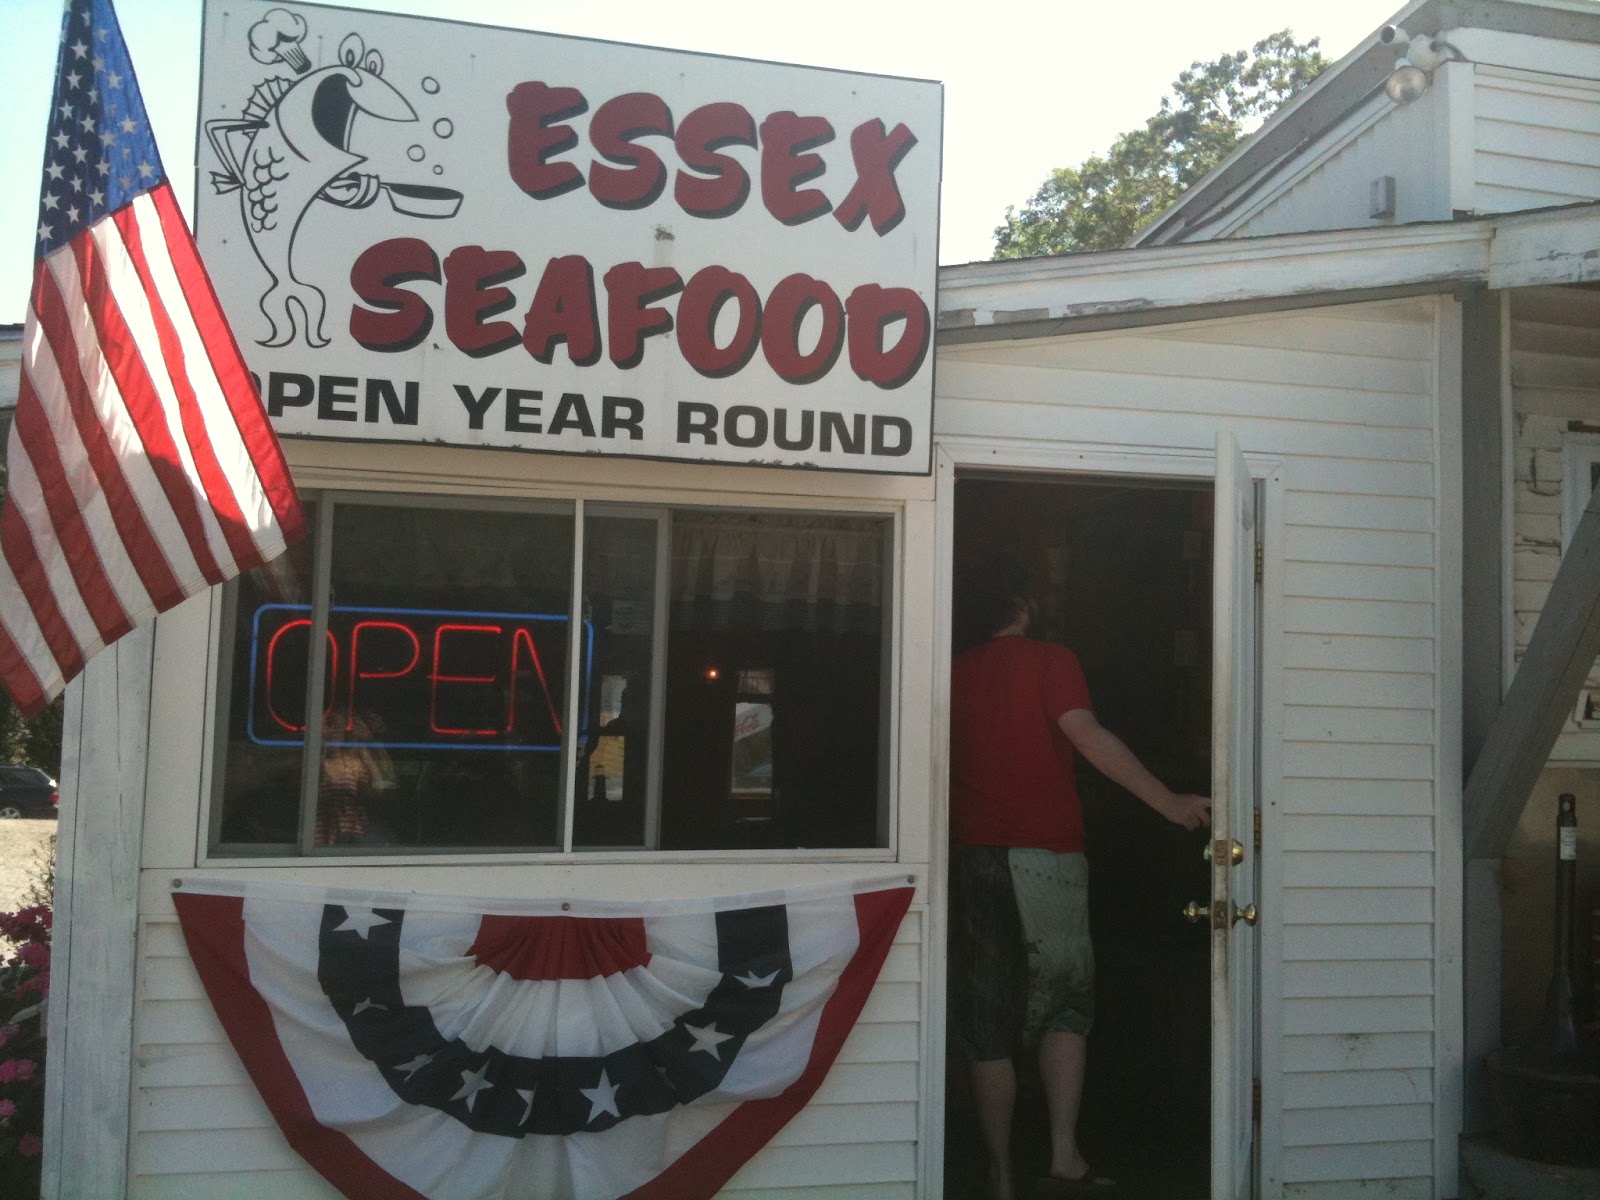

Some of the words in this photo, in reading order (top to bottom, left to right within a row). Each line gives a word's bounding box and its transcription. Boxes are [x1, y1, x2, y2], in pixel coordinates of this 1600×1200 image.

[506, 81, 919, 236] ESSEX
[349, 238, 932, 390] SEAFOOD
[254, 371, 420, 425] PEN
[453, 384, 645, 441] YEAR
[676, 402, 913, 457] ROUND
[266, 620, 566, 736] OPEN
